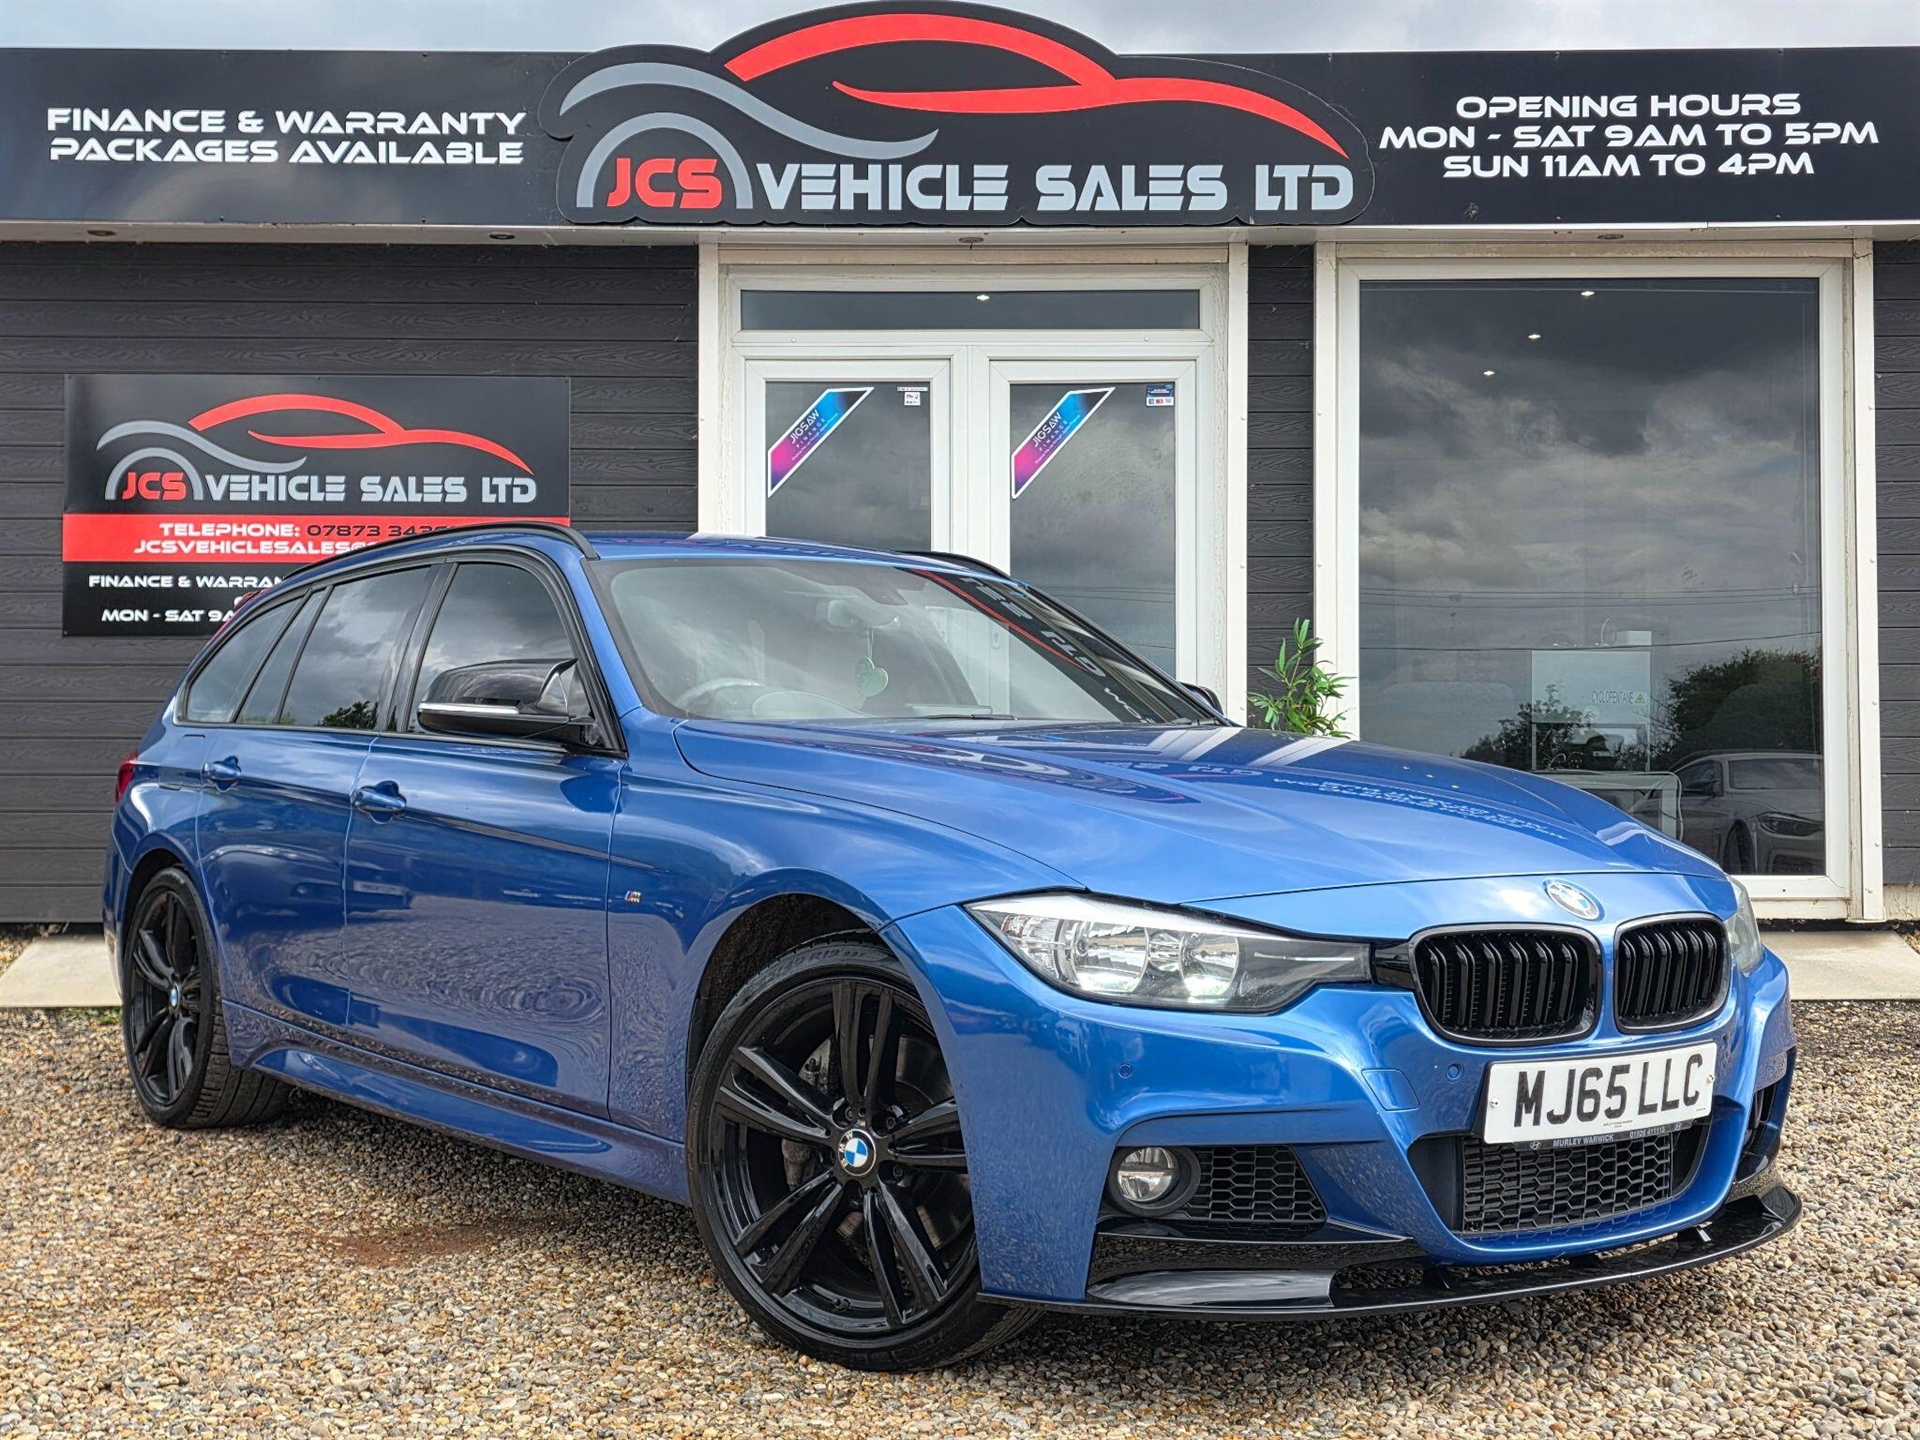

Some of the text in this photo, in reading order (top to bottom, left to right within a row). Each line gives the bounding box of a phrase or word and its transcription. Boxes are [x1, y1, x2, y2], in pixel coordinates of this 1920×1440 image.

[1457, 94, 1800, 118] OPENING HOURS
[48, 108, 526, 134] FINANCE & WARRANTY
[1379, 126, 1474, 148] MON
[1514, 126, 1595, 147] SAT
[1605, 124, 1706, 146] 9AM
[1715, 124, 1771, 145] TO
[1785, 122, 1878, 144] 5PM
[51, 138, 523, 164] PACKAGES AVAILABLE
[1444, 152, 1814, 177] SUN 11AM TO 4PM
[608, 158, 1353, 210] JCS VEHICLE SALES LTD
[789, 409, 820, 444] JIGSAW
[796, 418, 825, 448] FINANCE
[1032, 411, 1062, 447] JIGSAW
[1039, 420, 1068, 451] FINANCE
[123, 473, 537, 503] JCS VEHICLE SALES LTD
[160, 523, 300, 537] TELEPHONE:
[307, 525, 380, 537] 07873
[89, 575, 174, 588] FINANCE
[178, 576, 191, 588] &
[101, 609, 149, 622] MON
[165, 610, 204, 622] SAT
[1514, 1053, 1704, 1127] MJ65 LLC
[1553, 1137, 1583, 1148] MURLEY
[1582, 1134, 1614, 1146] WARWICK
